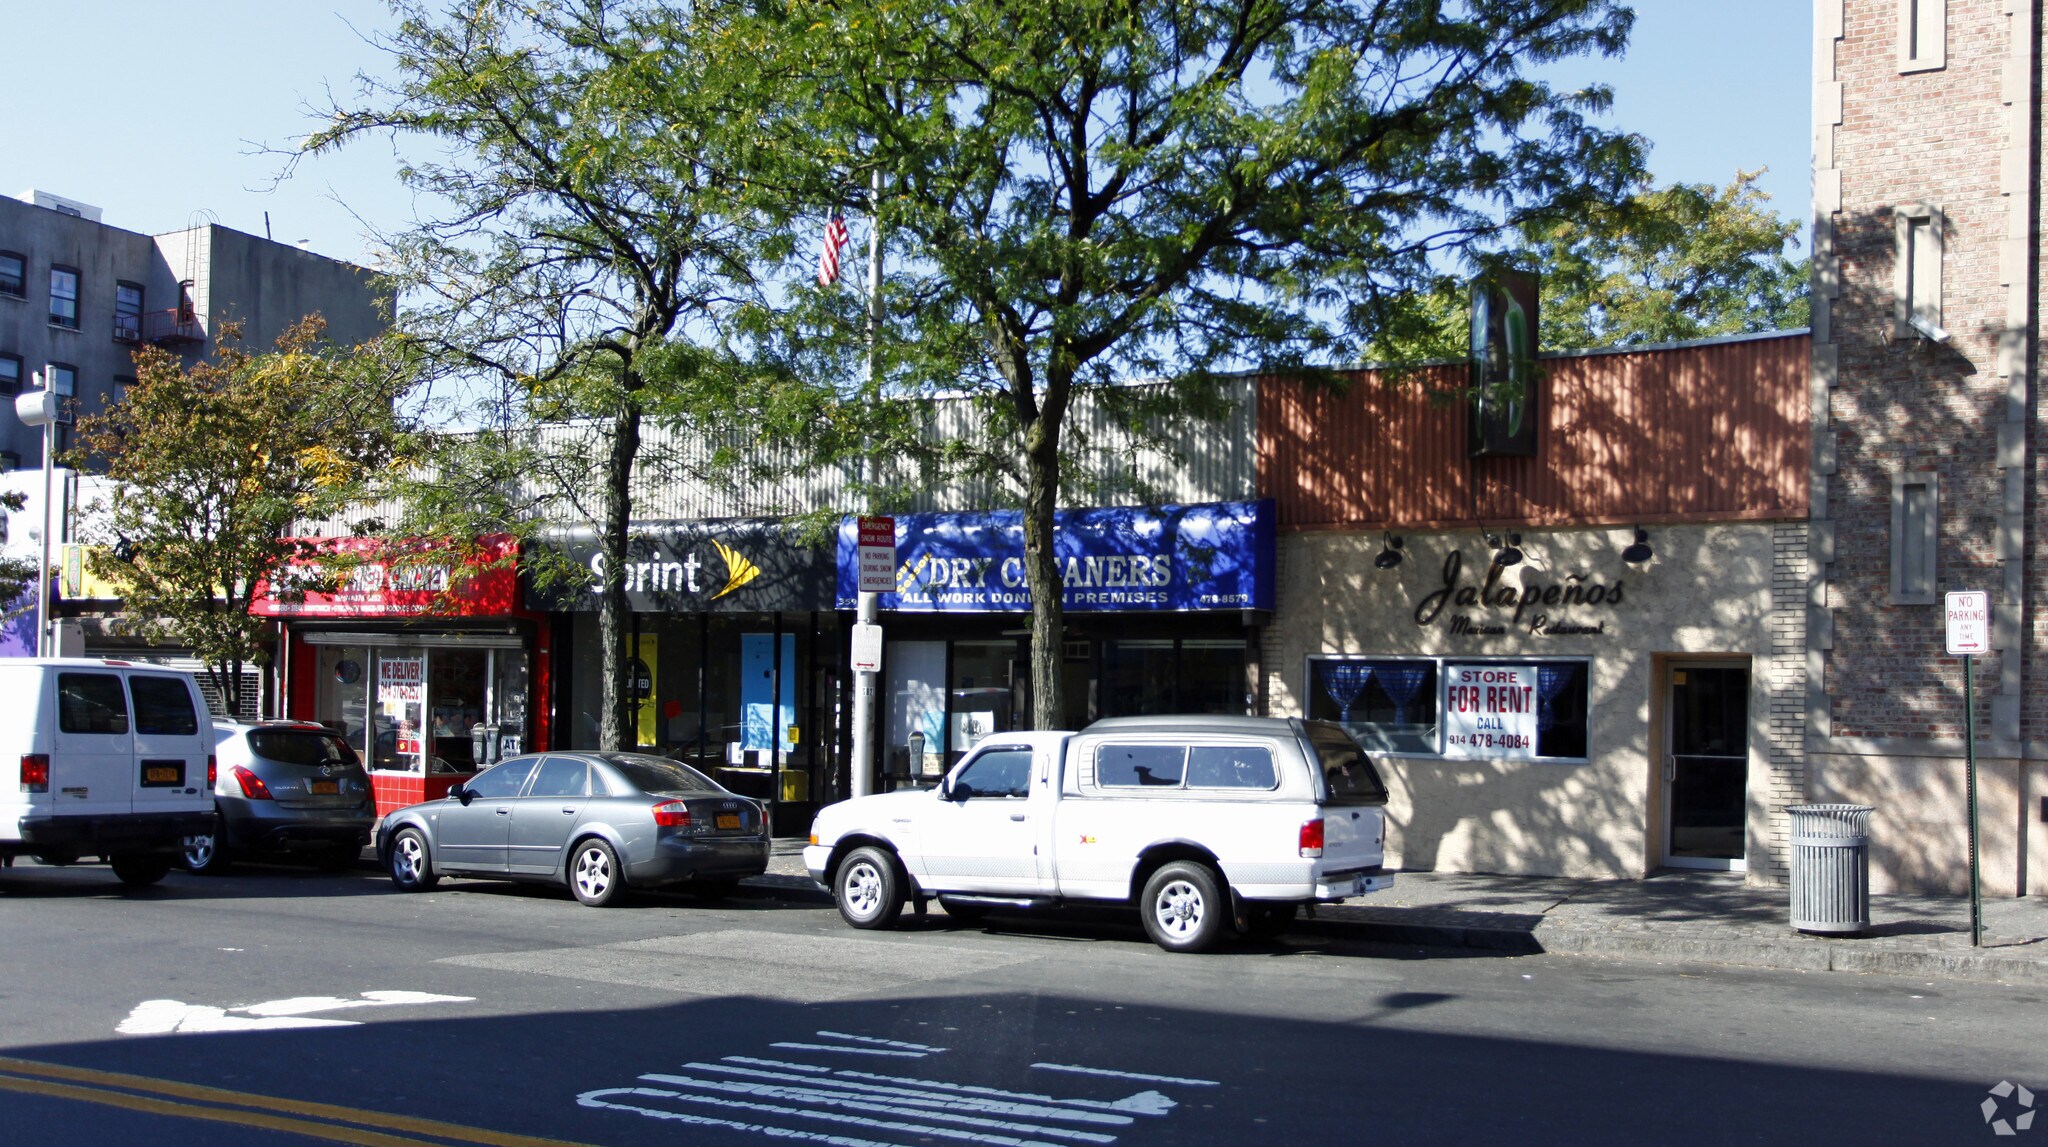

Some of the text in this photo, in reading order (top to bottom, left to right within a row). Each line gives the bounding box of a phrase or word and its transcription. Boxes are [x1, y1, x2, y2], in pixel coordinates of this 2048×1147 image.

[861, 522, 891, 530] EMERGENCY
[876, 535, 892, 543] ROUTE
[865, 551, 889, 560] NO PARKING
[863, 564, 878, 572] DURING
[896, 559, 911, 581] our
[928, 554, 1171, 589] DRY CANERS
[863, 577, 892, 585] EMERGENCIES
[1414, 550, 1623, 626] Jalapeños
[838, 598, 857, 606] 359
[902, 593, 932, 603] ALL
[937, 593, 986, 603] WORK
[1075, 592, 1168, 603] PREMISES
[1200, 594, 1248, 603] 478-8579
[1958, 596, 1973, 607] NO
[1948, 610, 1984, 621] PARKING
[1449, 614, 1604, 635] Mexican Restaurant
[381, 661, 420, 679] WE DELIVER
[1461, 671, 1517, 683] STORE
[1447, 686, 1532, 713] FOR RENT
[1476, 717, 1503, 729] CALL
[1449, 734, 1529, 748] 914 478-4084
